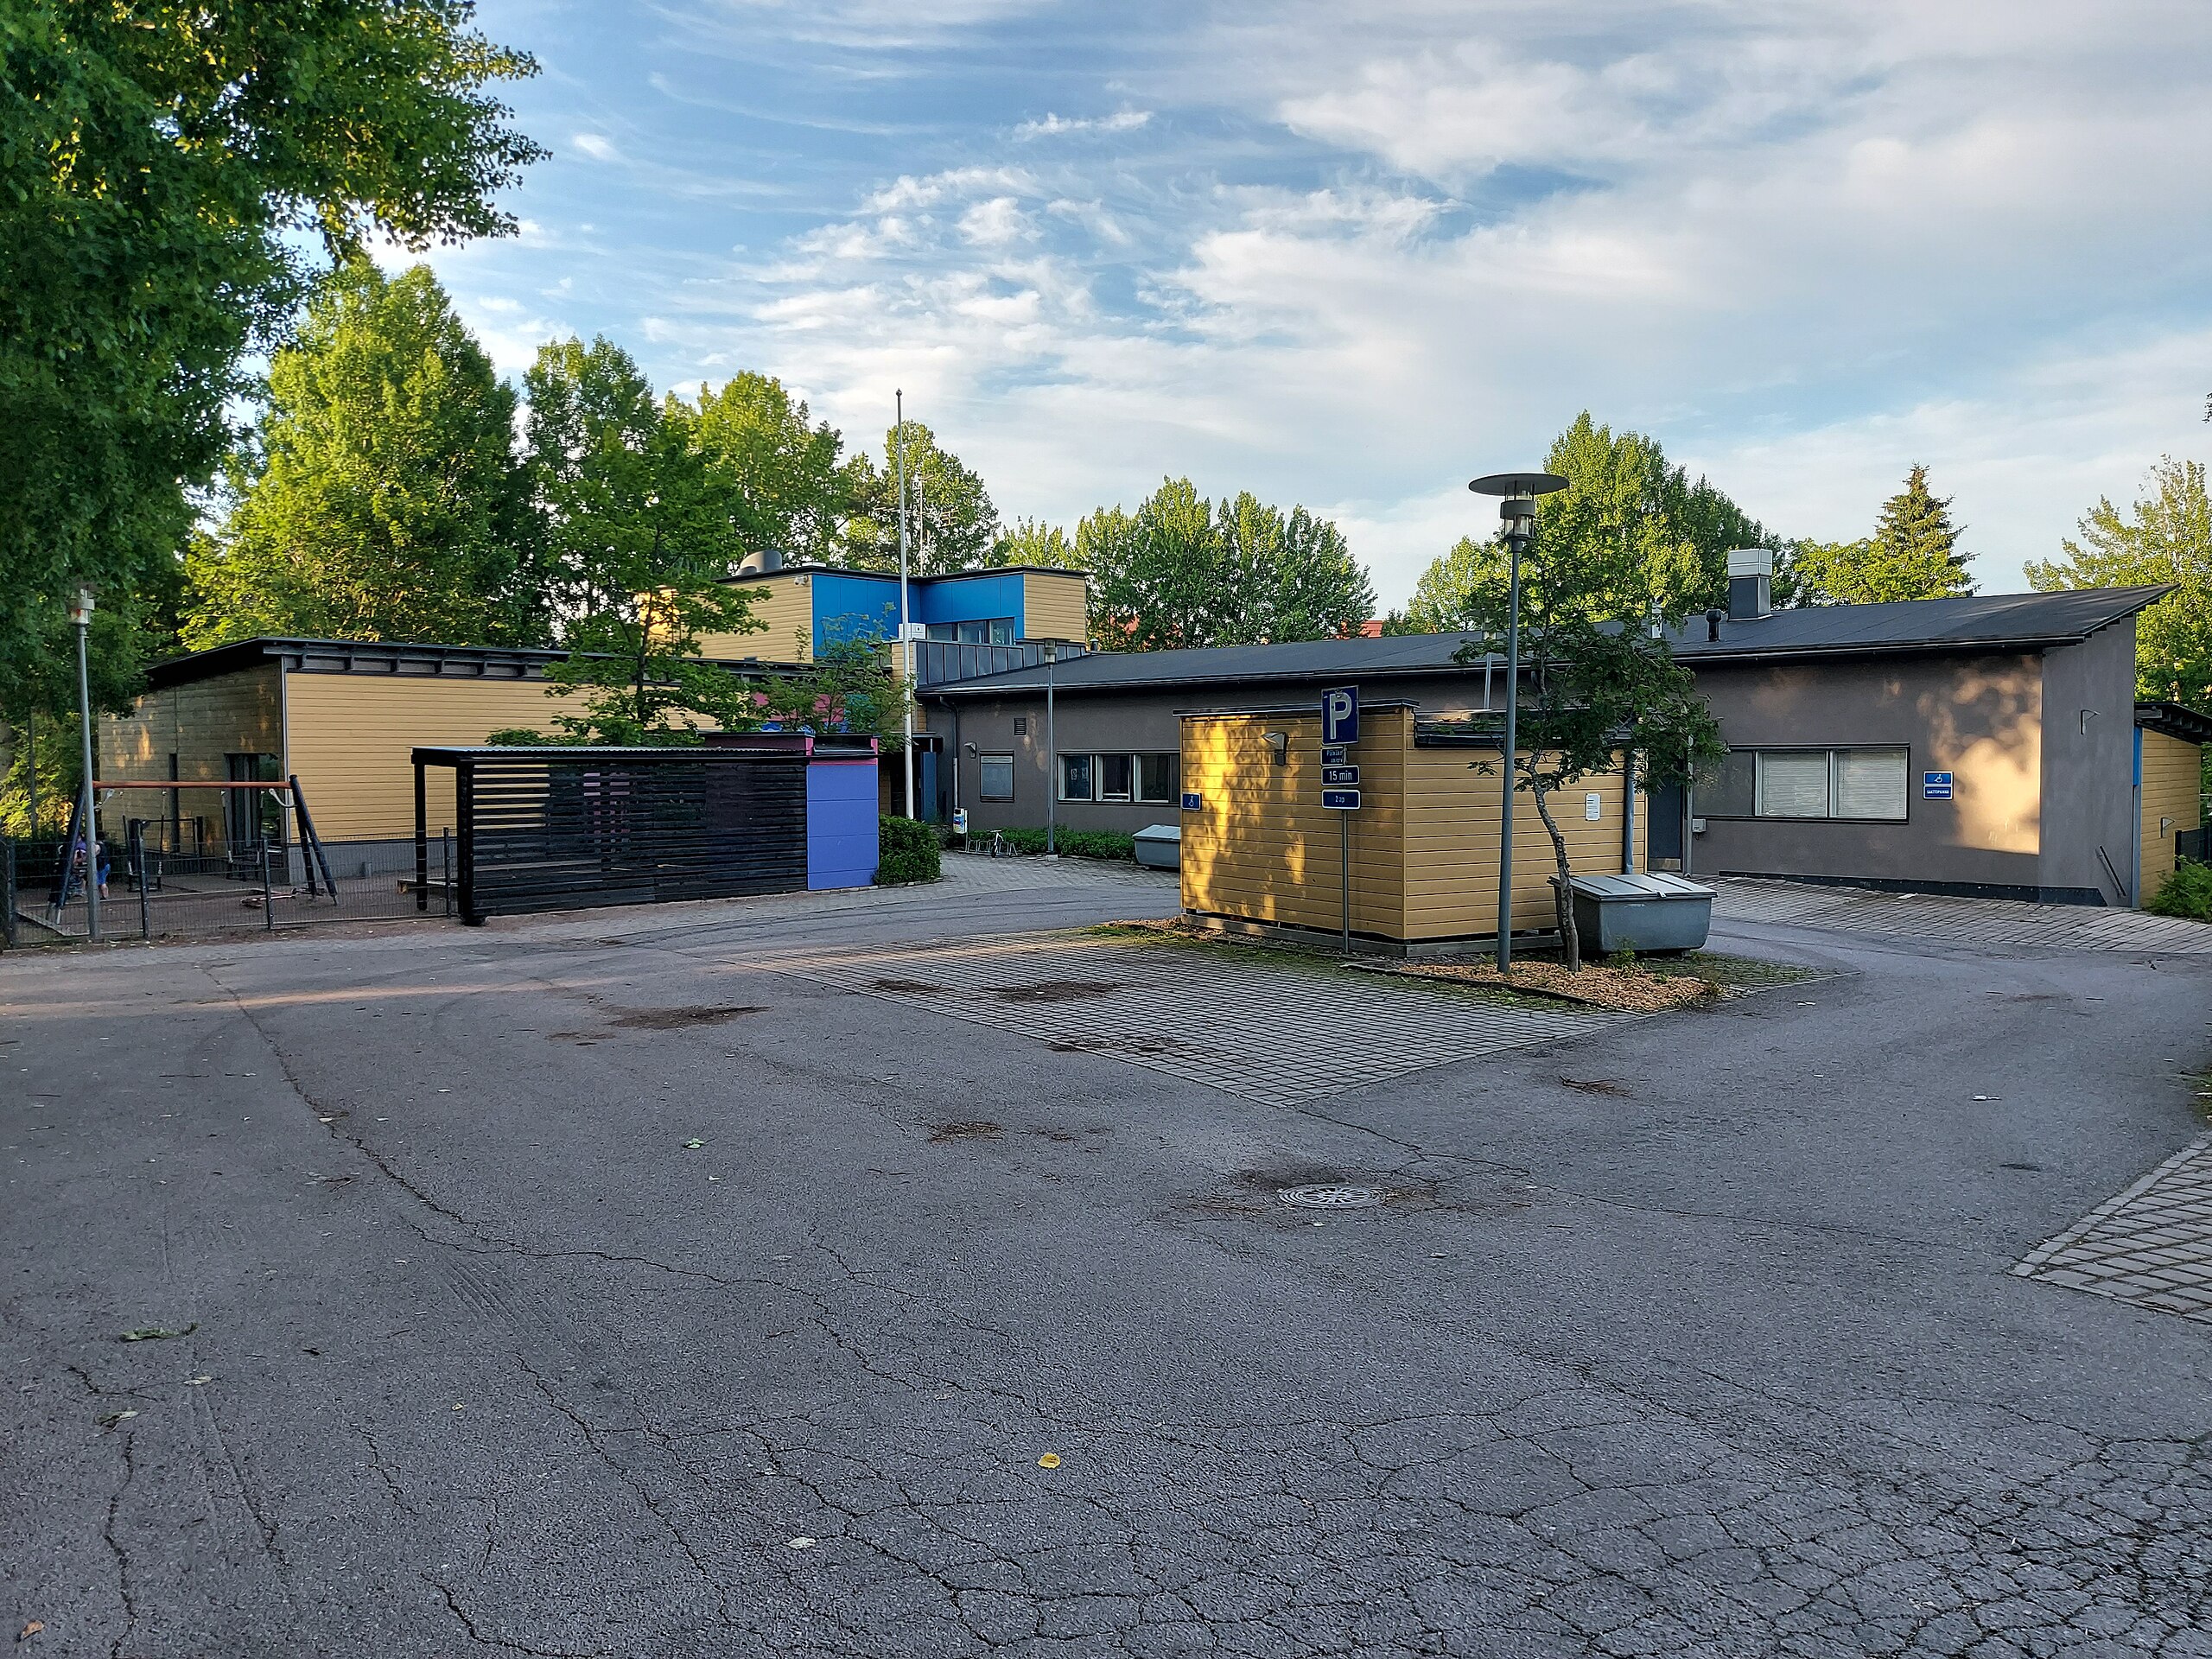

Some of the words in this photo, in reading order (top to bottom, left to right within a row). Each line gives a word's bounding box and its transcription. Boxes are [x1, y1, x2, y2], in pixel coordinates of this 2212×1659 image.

[1329, 692, 1352, 740] P
[1329, 770, 1338, 782] 15
[1338, 769, 1353, 781] min
